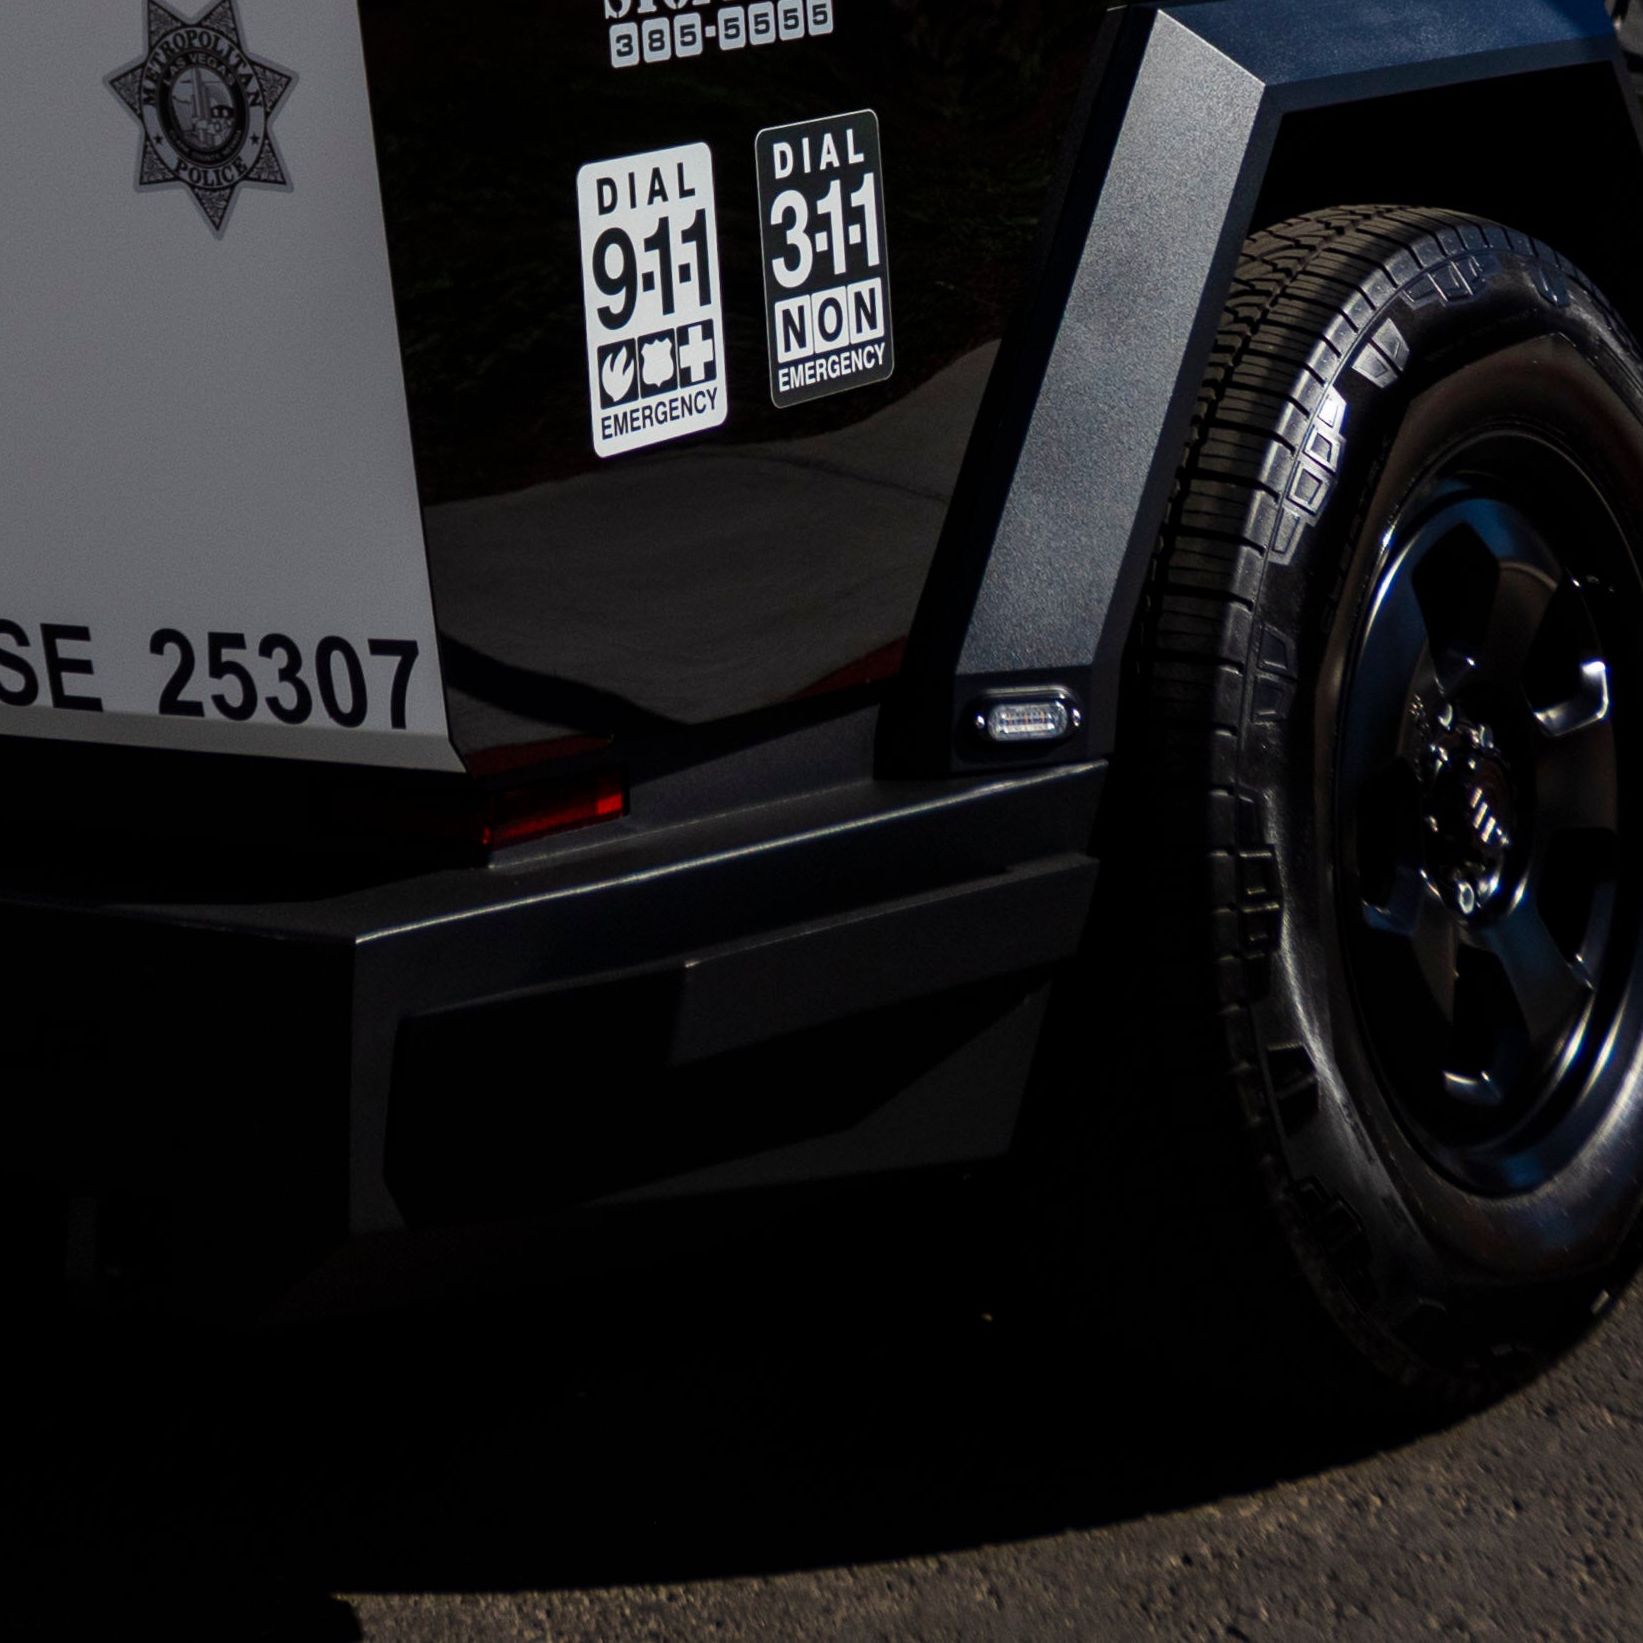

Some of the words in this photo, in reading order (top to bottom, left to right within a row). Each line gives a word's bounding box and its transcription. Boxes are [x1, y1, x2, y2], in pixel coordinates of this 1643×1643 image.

[615, 2, 830, 57] 385-5555
[143, 29, 262, 107] METROPOLITAN
[189, 54, 236, 87] VEGAS
[175, 156, 247, 188] POLICE
[773, 128, 865, 180] DIAL
[596, 162, 696, 217] DIAL
[781, 286, 878, 355] NON
[778, 342, 886, 393] EMERGENCY
[601, 387, 718, 441] EMERGENCY
[149, 627, 420, 730] 25307
